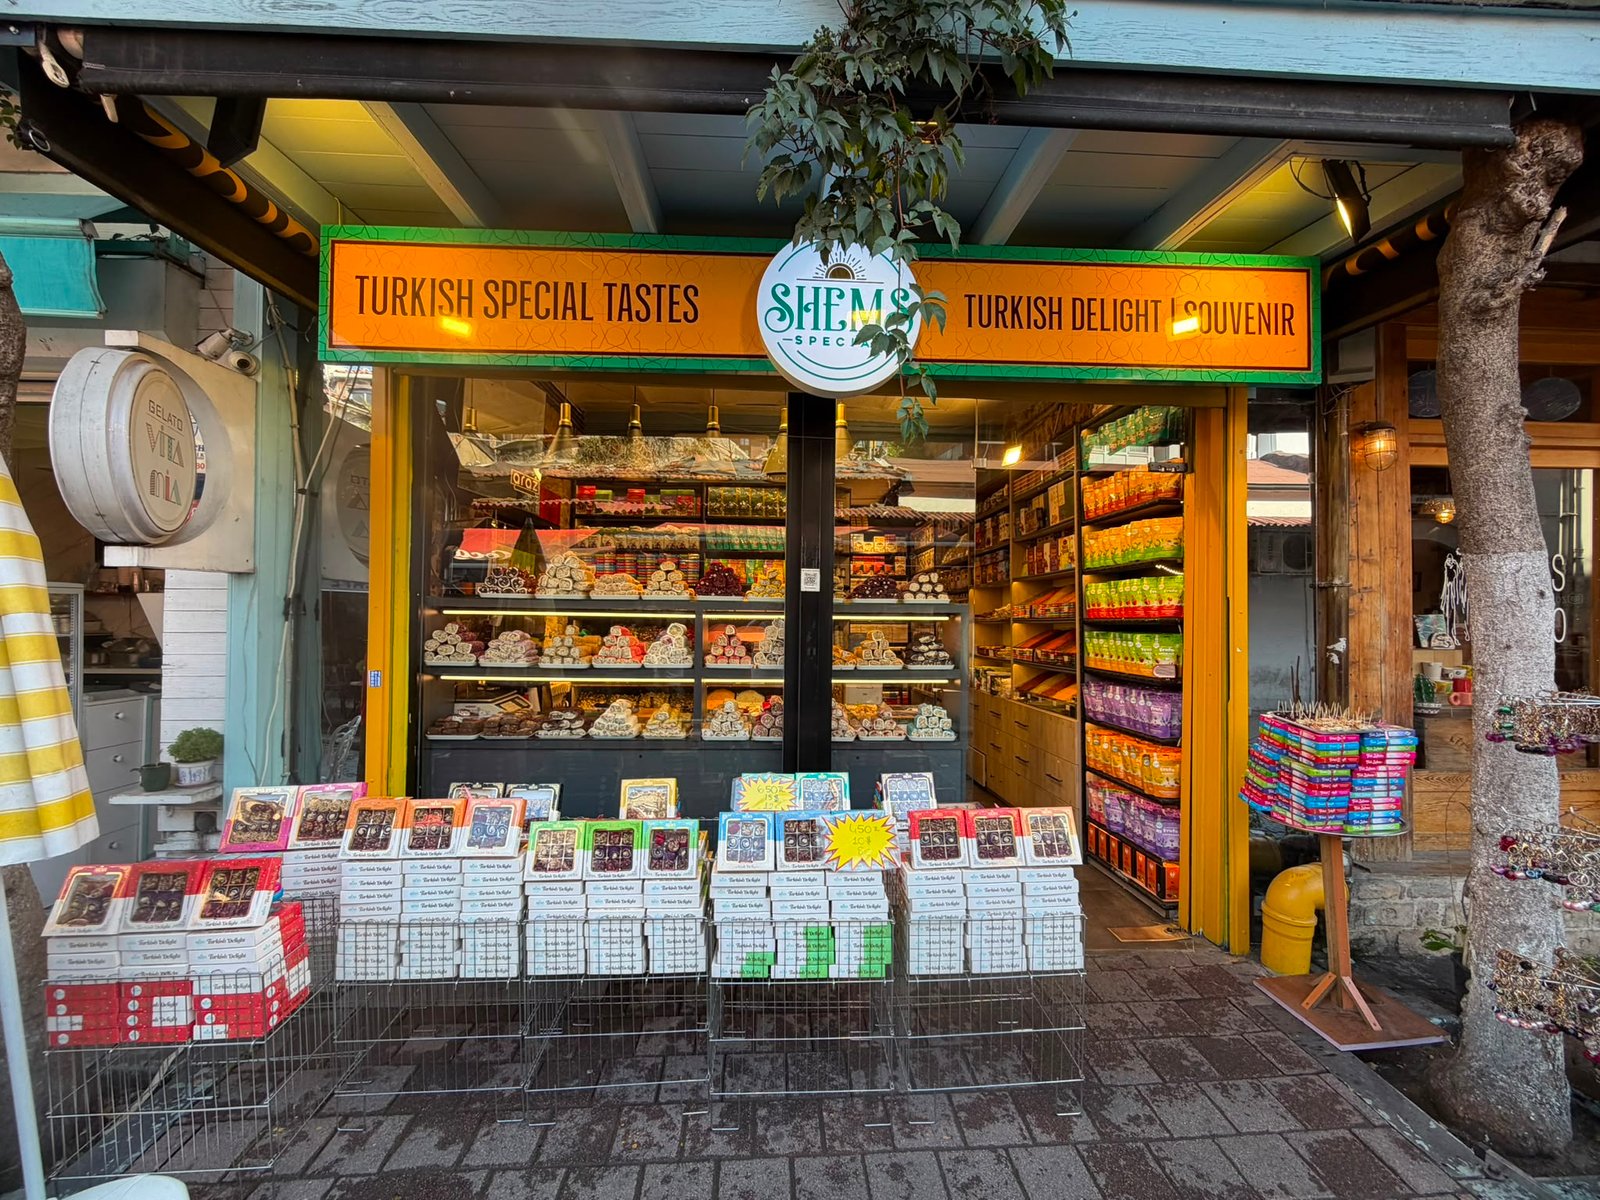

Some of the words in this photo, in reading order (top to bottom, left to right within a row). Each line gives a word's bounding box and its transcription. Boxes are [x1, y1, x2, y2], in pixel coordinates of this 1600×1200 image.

[356, 275, 473, 318] TURKISH
[484, 279, 593, 322] SPECIAL
[603, 282, 698, 324] TASTES
[764, 283, 914, 335] SHEMS
[964, 294, 1062, 331] TURKISH
[1072, 296, 1160, 333] DELIGHT
[1183, 300, 1296, 336] SOUVENIR
[149, 400, 182, 431] GELATO
